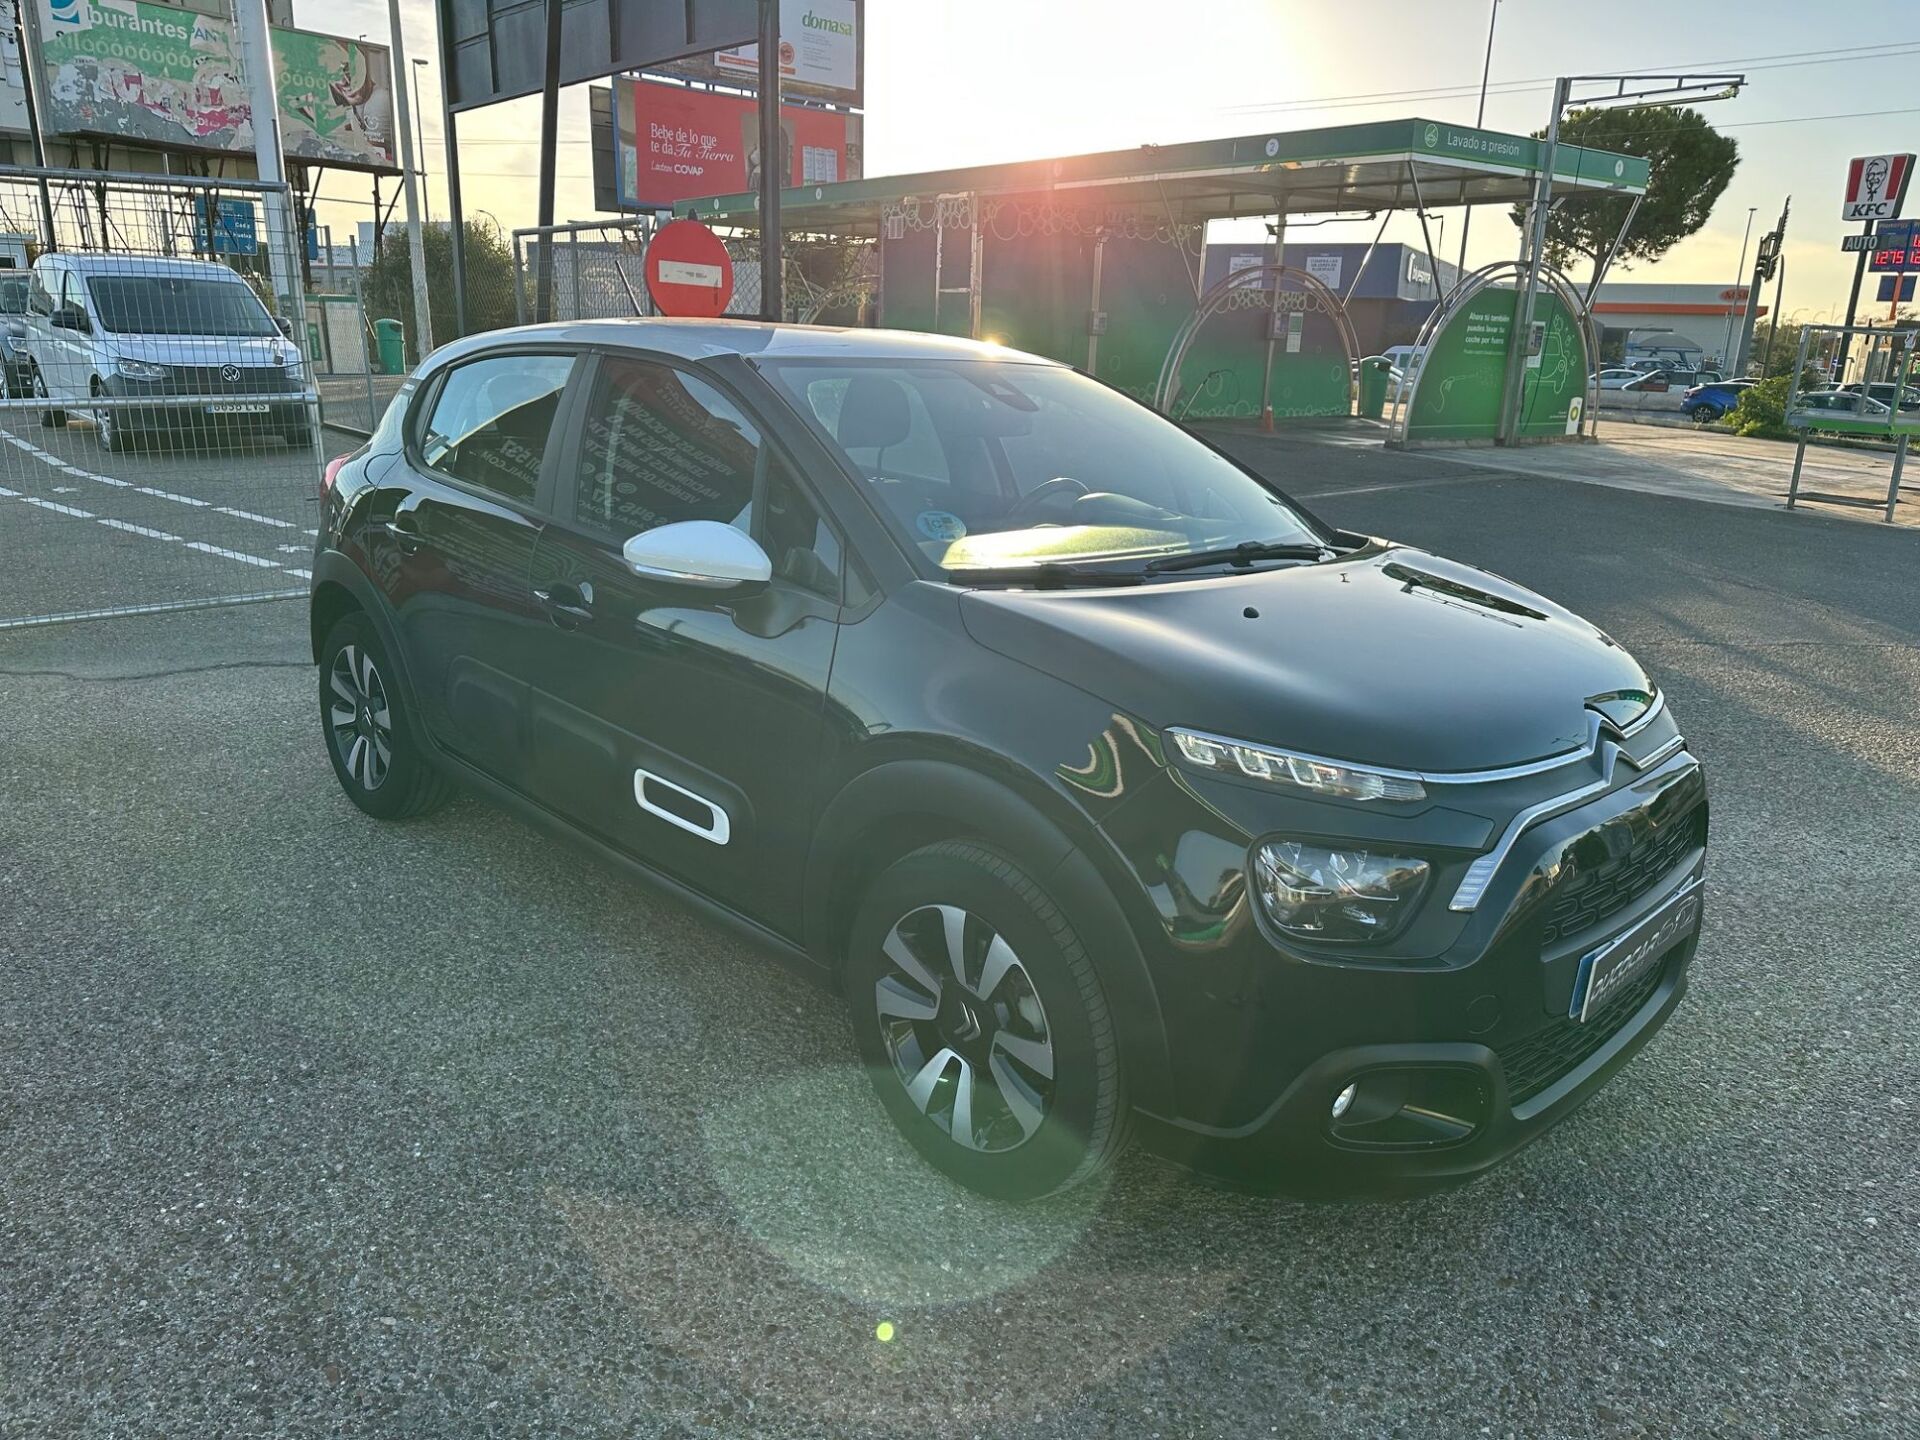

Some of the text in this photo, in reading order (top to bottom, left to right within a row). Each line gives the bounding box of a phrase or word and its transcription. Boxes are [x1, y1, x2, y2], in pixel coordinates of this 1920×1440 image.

[801, 9, 853, 36] domasa
[651, 122, 718, 149] Bebe de lo que
[1447, 131, 1520, 157] Lavado a presión
[650, 140, 660, 154] te
[661, 140, 674, 156] da
[695, 145, 735, 163] Tierra
[674, 163, 704, 176] COVAP
[1850, 203, 1888, 217] KFC
[1845, 236, 1878, 250] AUTO
